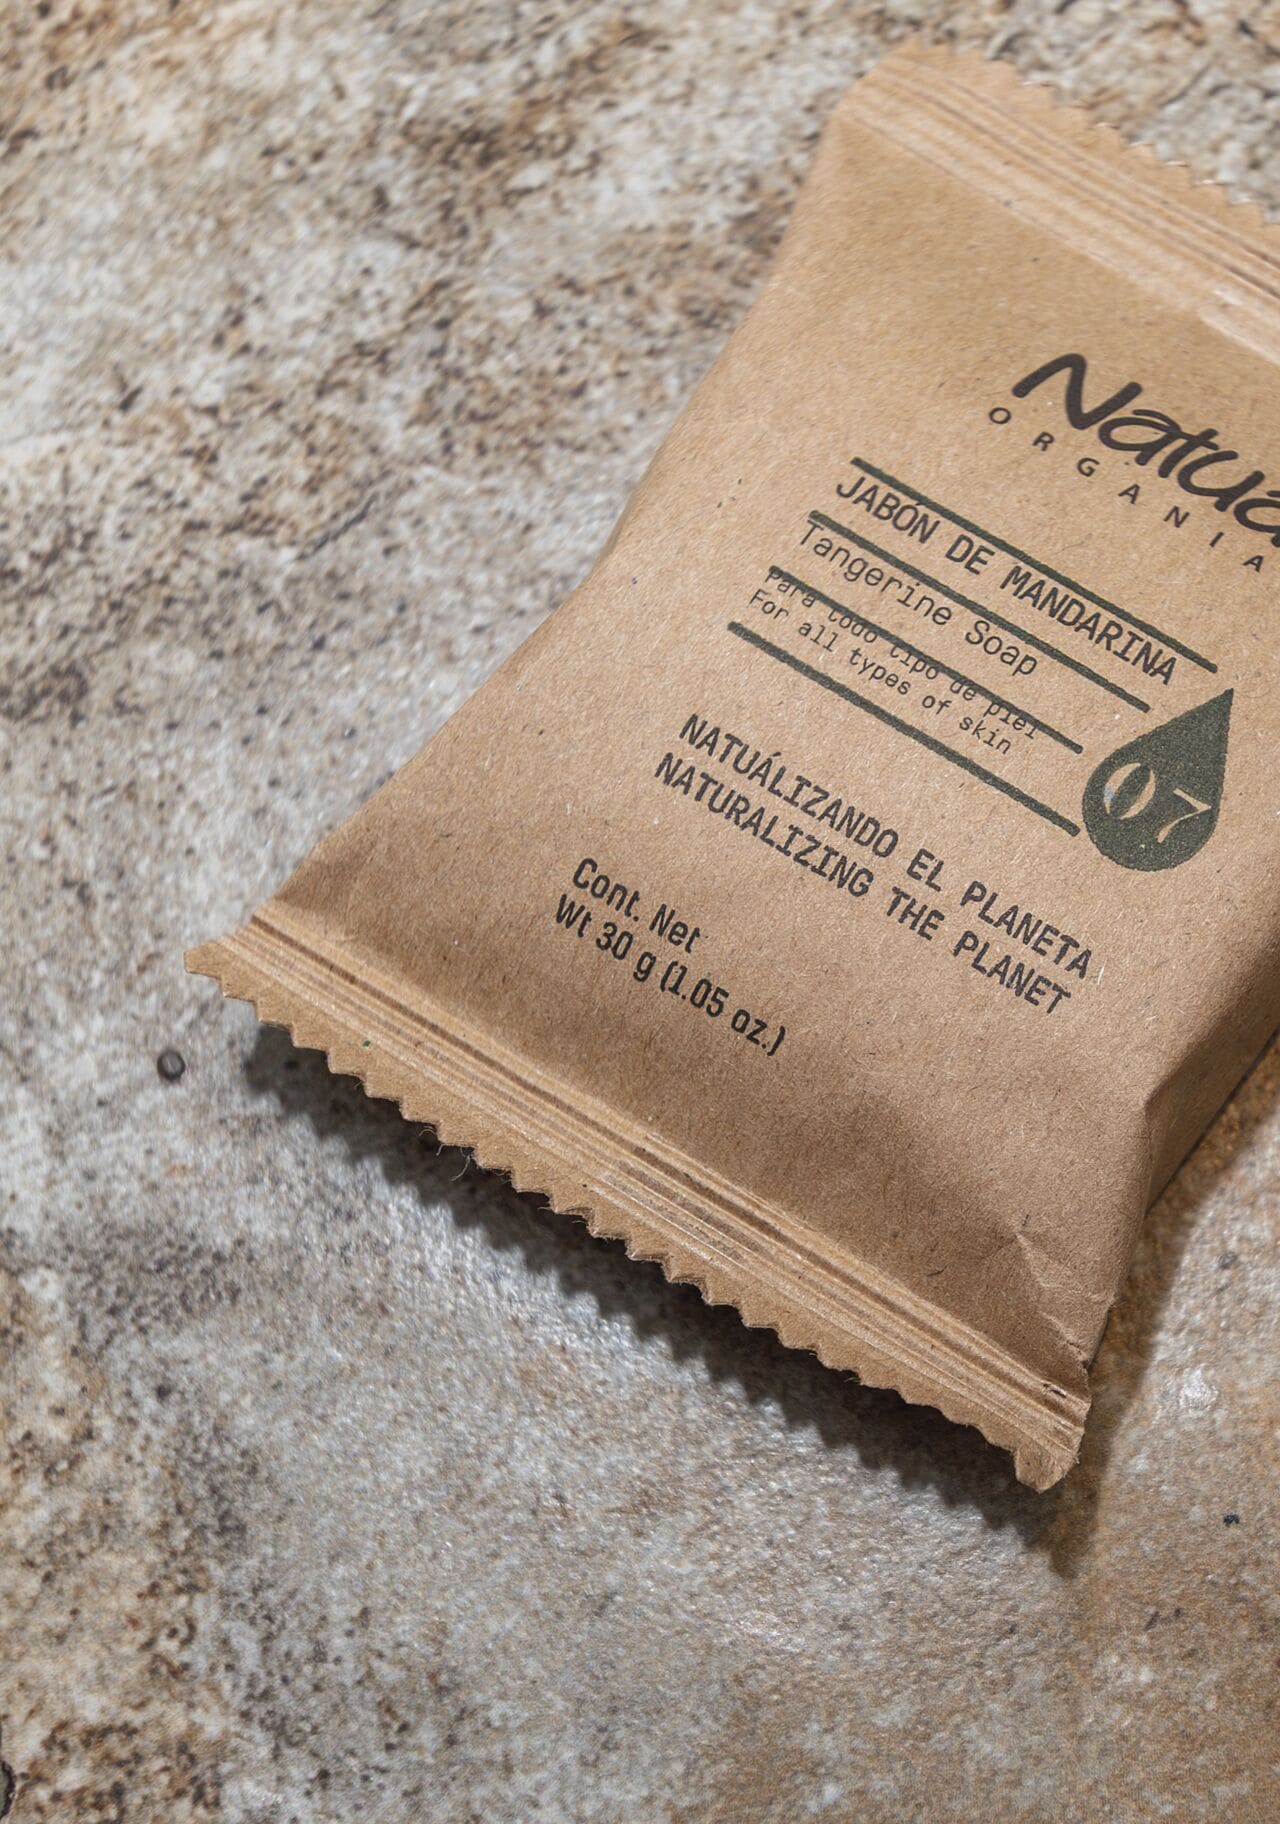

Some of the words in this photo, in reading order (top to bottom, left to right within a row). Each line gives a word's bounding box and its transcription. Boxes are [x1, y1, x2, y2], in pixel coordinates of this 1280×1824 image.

[988, 407, 1265, 572] ORGANIA
[798, 520, 953, 627] Tangerine
[965, 620, 1038, 678] Soap
[836, 476, 941, 544] JABÓN
[945, 534, 995, 576] DE
[1000, 565, 1178, 687] MANDARINA
[750, 588, 789, 621] For
[798, 621, 840, 652] all
[849, 648, 912, 696] types
[921, 694, 953, 715] of
[959, 715, 1012, 755] skin
[654, 752, 875, 898] NATURALIZING
[886, 886, 945, 942] THE
[952, 930, 1072, 1015] PLANET
[679, 712, 900, 860] NATUÁLIZANDO
[905, 848, 945, 892] EL
[959, 881, 1094, 979] PLANETA
[1103, 761, 1213, 844] 07
[555, 893, 593, 938] Wt
[596, 922, 634, 960] 30
[633, 951, 657, 982] g
[659, 960, 730, 1018] (1.05
[731, 1008, 786, 1057] oz.)
[572, 858, 641, 922] Cont.
[649, 903, 700, 954] Net
